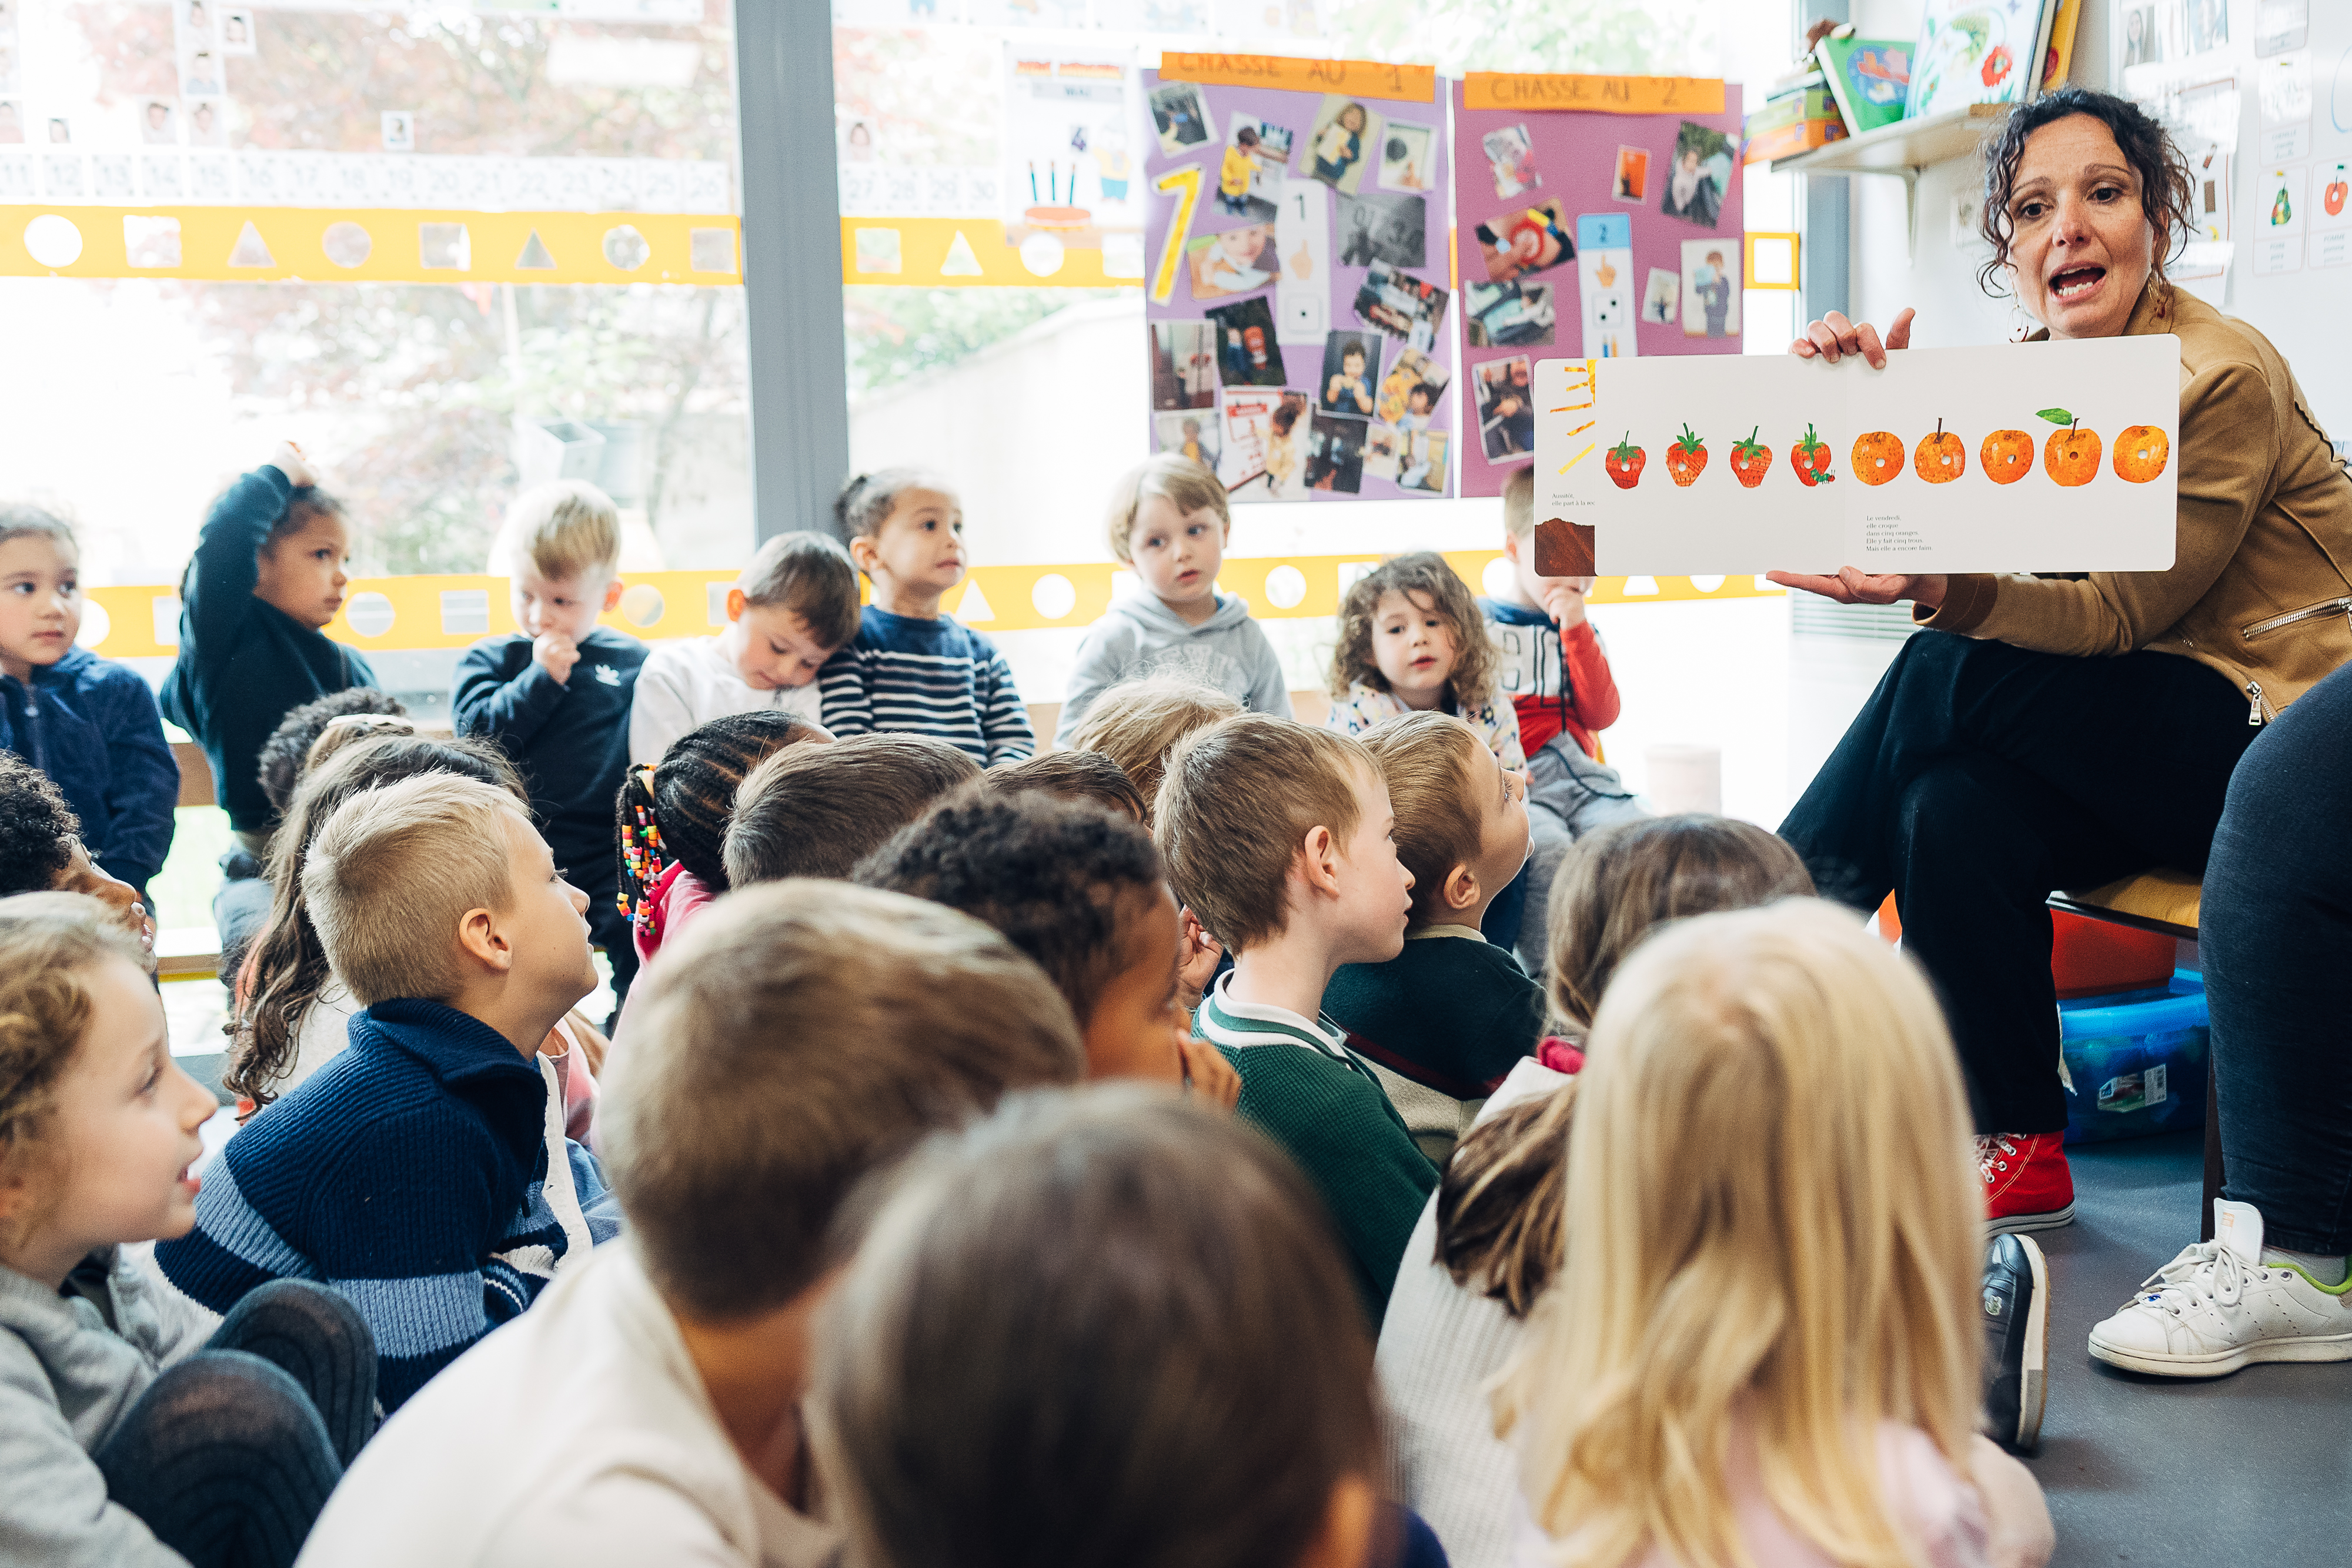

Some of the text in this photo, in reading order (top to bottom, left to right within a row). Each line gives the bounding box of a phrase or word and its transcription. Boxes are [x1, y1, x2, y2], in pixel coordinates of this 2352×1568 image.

[1178, 54, 1282, 78] CHASSE
[1307, 59, 1347, 85] AU
[1490, 78, 1591, 103] CHASSE
[1601, 79, 1631, 103] AU
[1293, 192, 1305, 222] 1
[1598, 223, 1608, 245] 2
